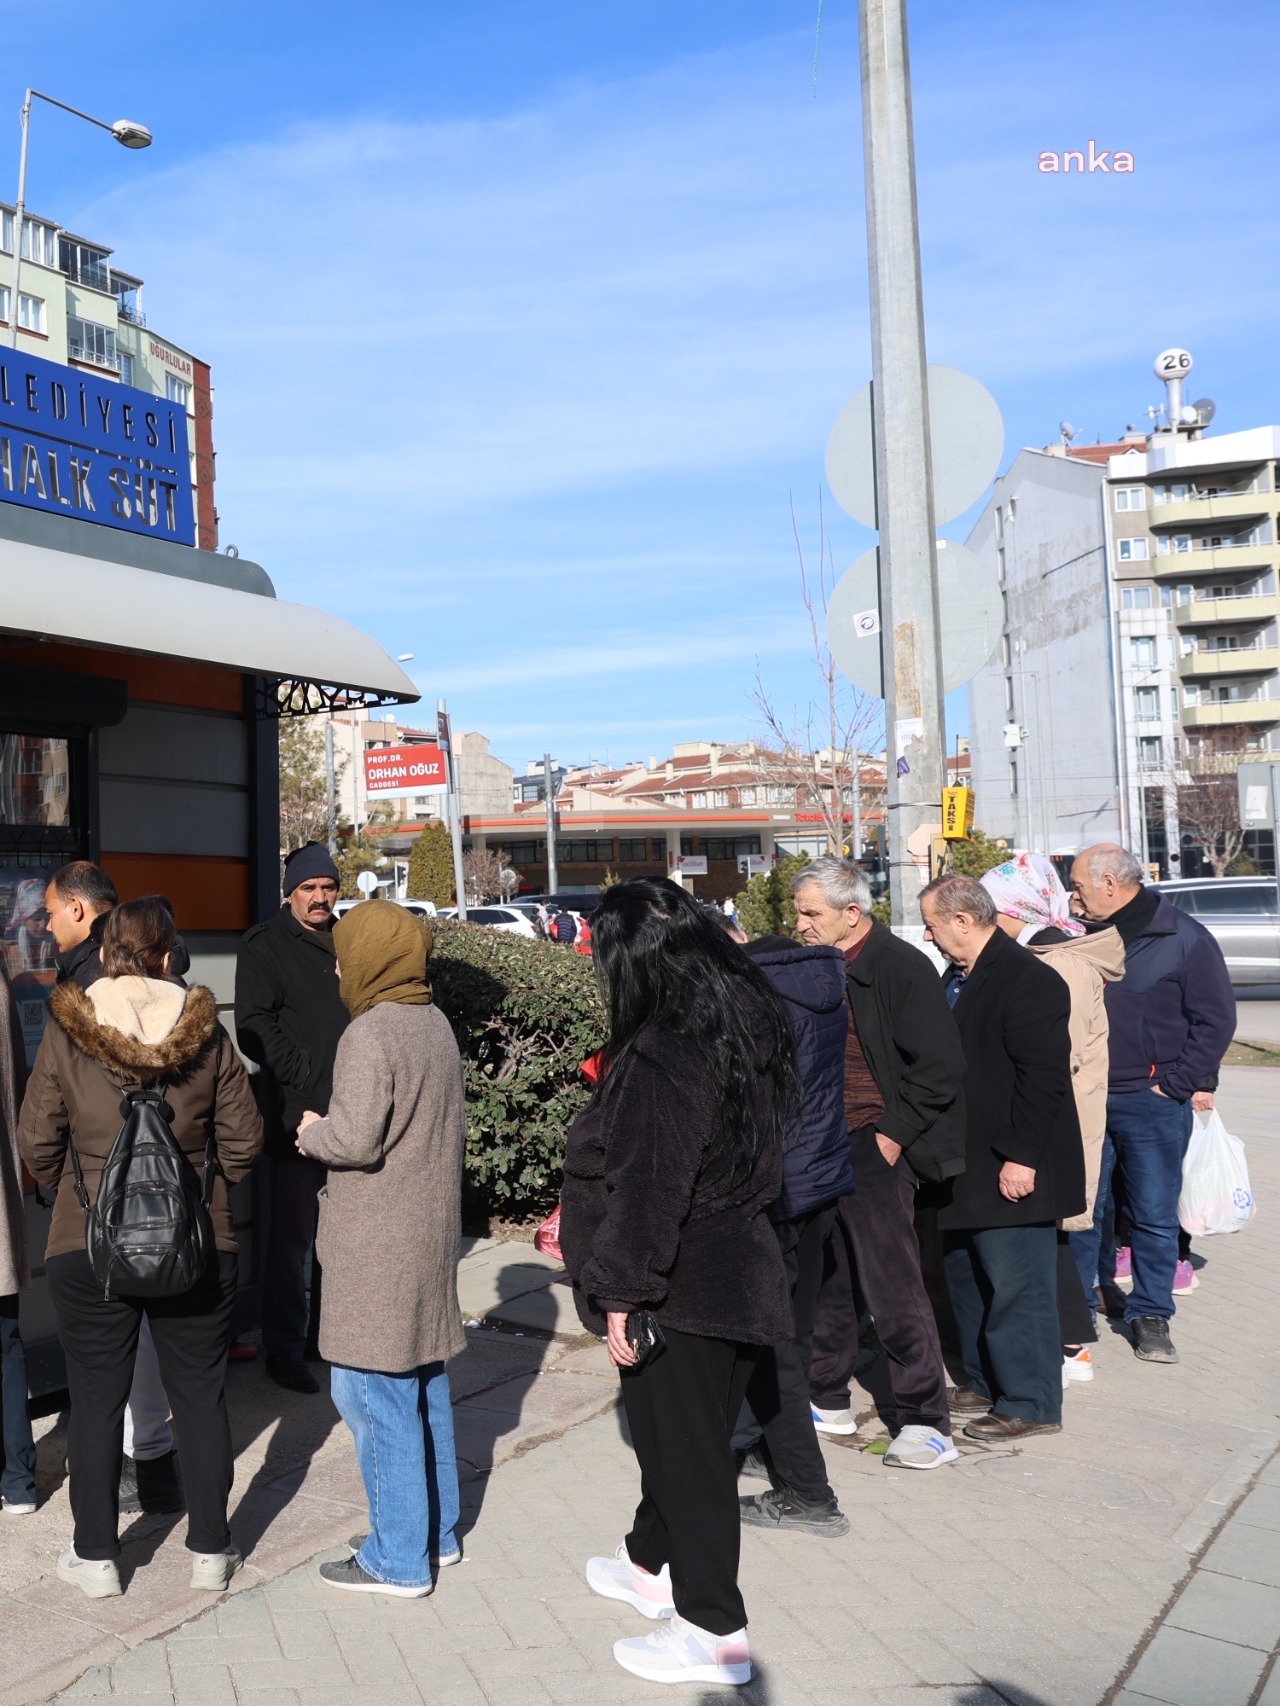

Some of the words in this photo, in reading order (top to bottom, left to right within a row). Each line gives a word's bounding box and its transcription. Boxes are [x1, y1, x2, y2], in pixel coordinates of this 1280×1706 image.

[149, 341, 192, 376] UĞURLULAR
[1162, 353, 1190, 371] 26
[108, 456, 178, 532] SÜT
[367, 754, 404, 764] PROF.DR.
[368, 766, 407, 780] ORHAN
[409, 762, 440, 776] OĞUZ
[369, 780, 399, 789] CADDESİ
